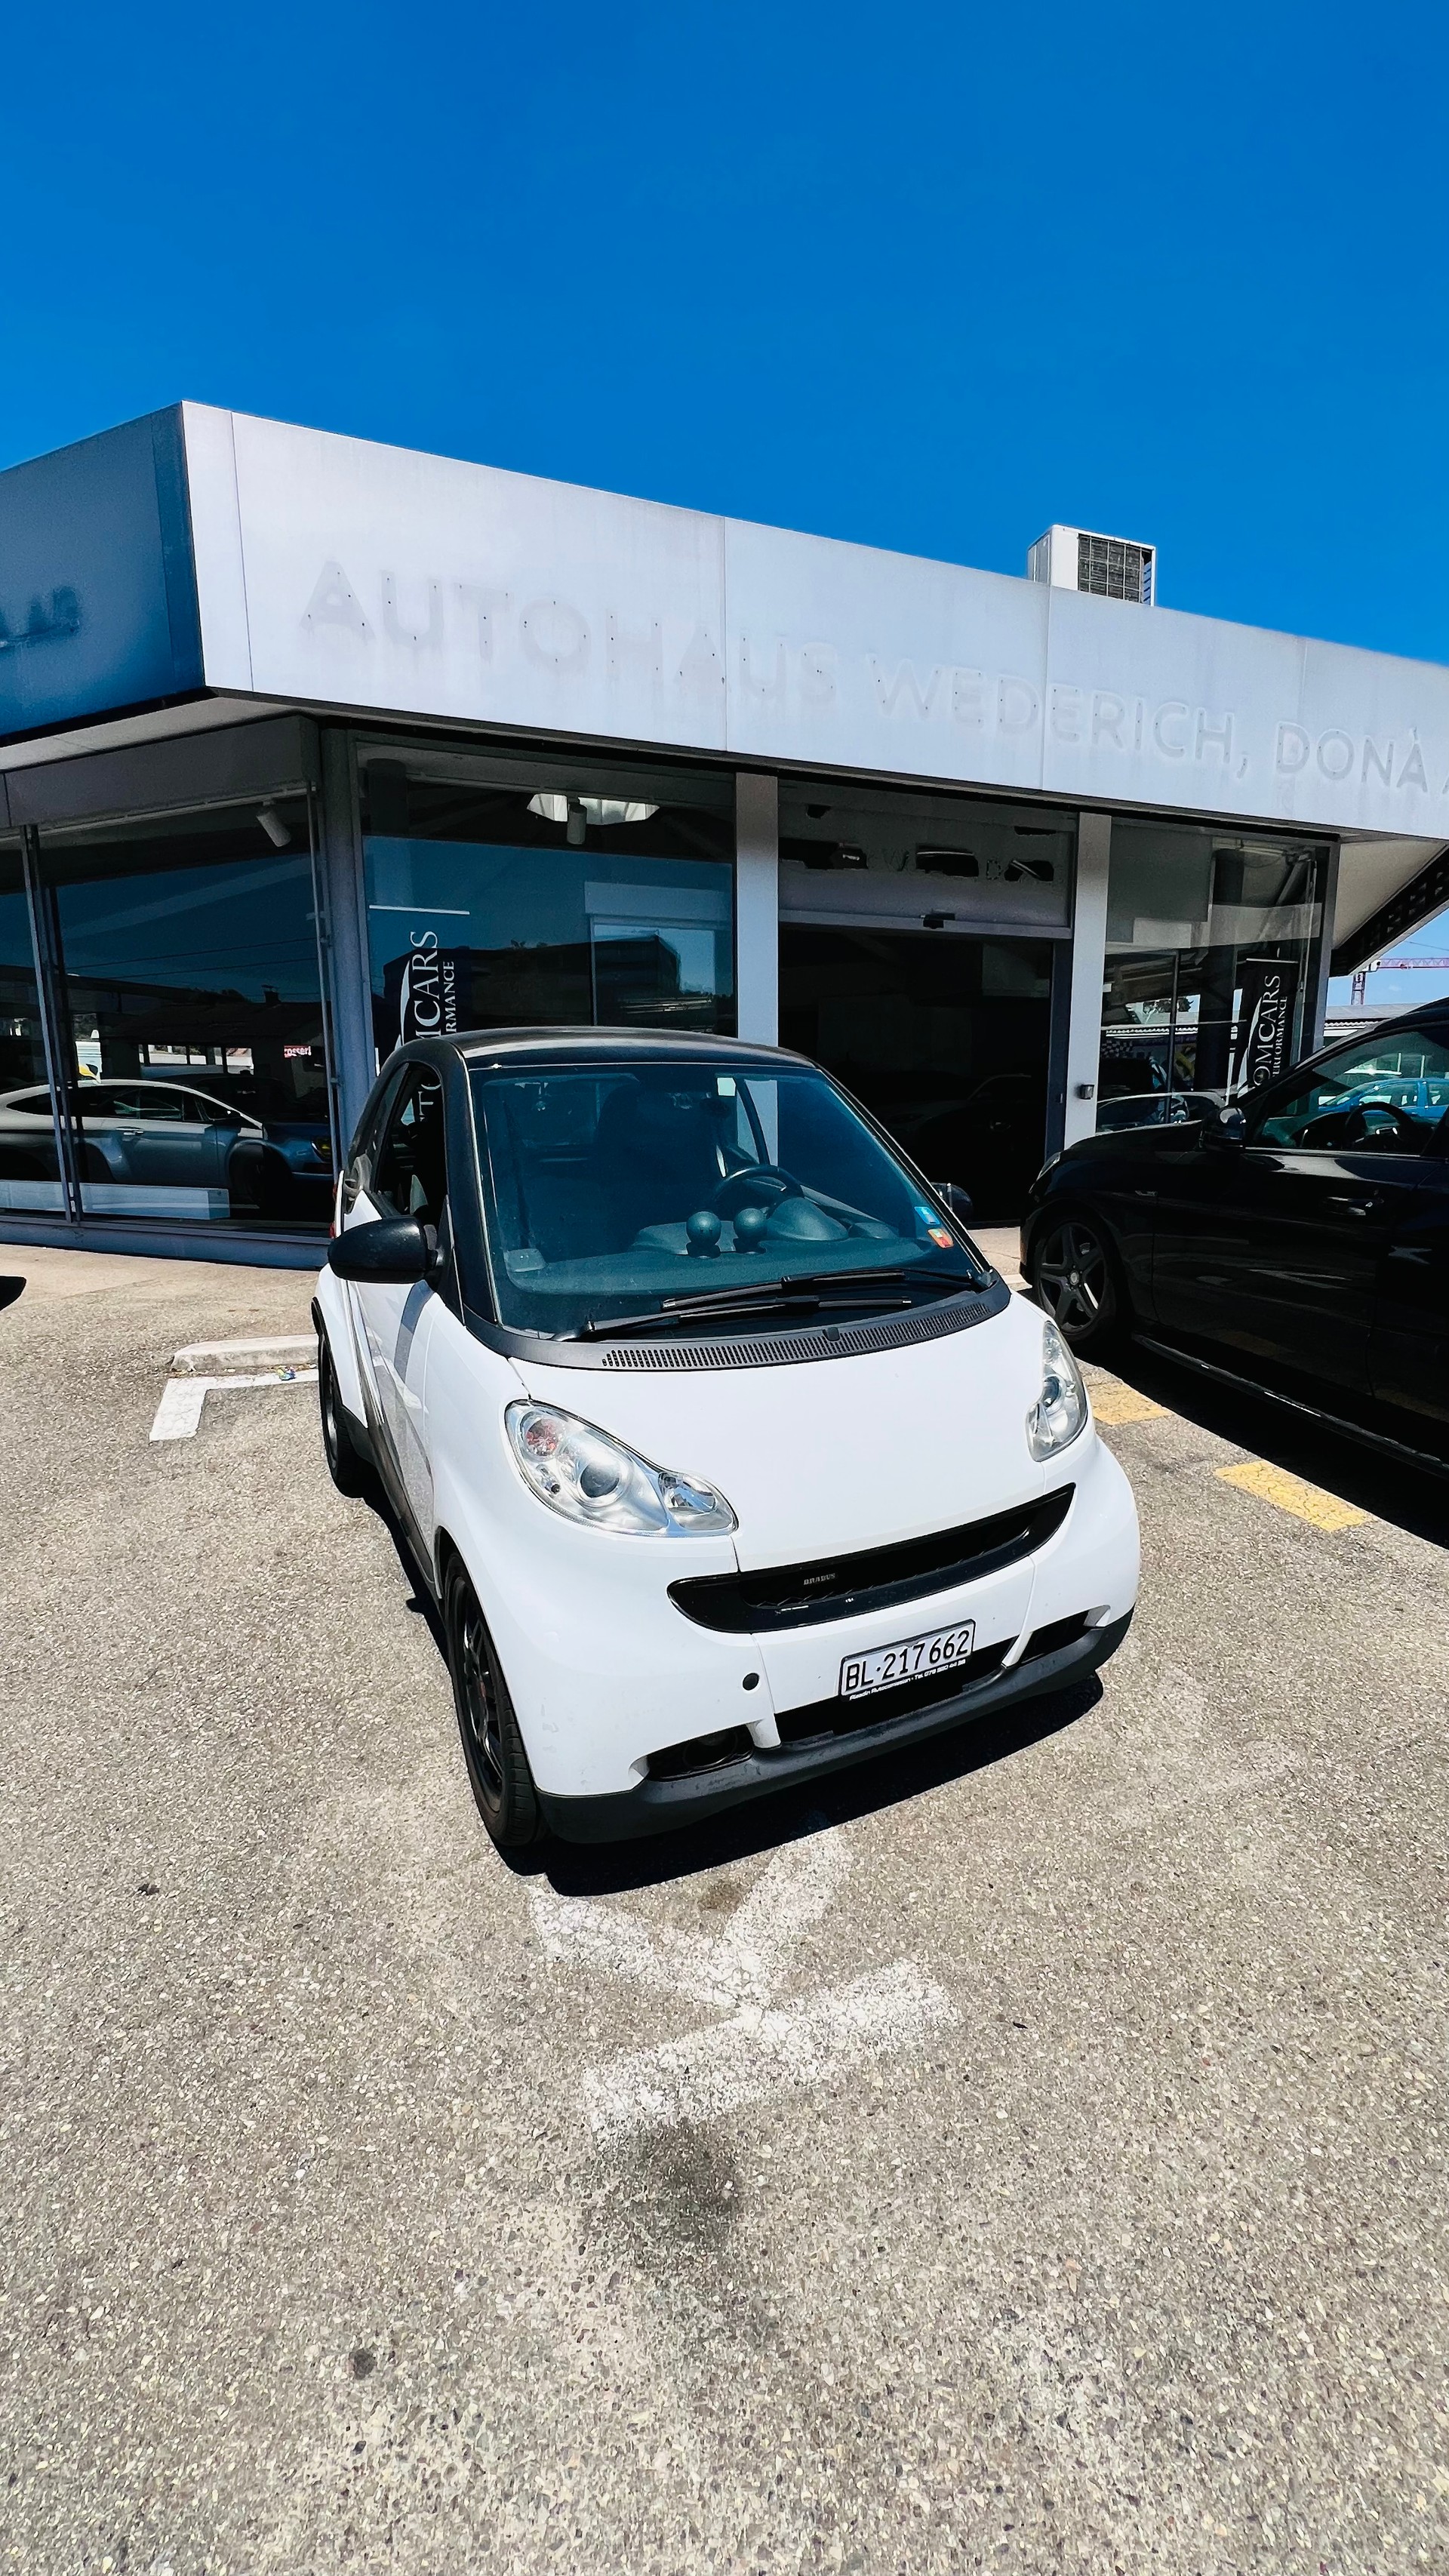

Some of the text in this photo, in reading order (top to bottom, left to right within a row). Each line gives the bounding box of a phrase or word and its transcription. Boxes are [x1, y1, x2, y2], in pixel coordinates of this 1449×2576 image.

[299, 559, 837, 703] AUTOHAUS
[865, 652, 1250, 780] WEDERICH,
[1272, 996, 1288, 1077] ERFORMANCE
[803, 1573, 835, 1586] BRABUS
